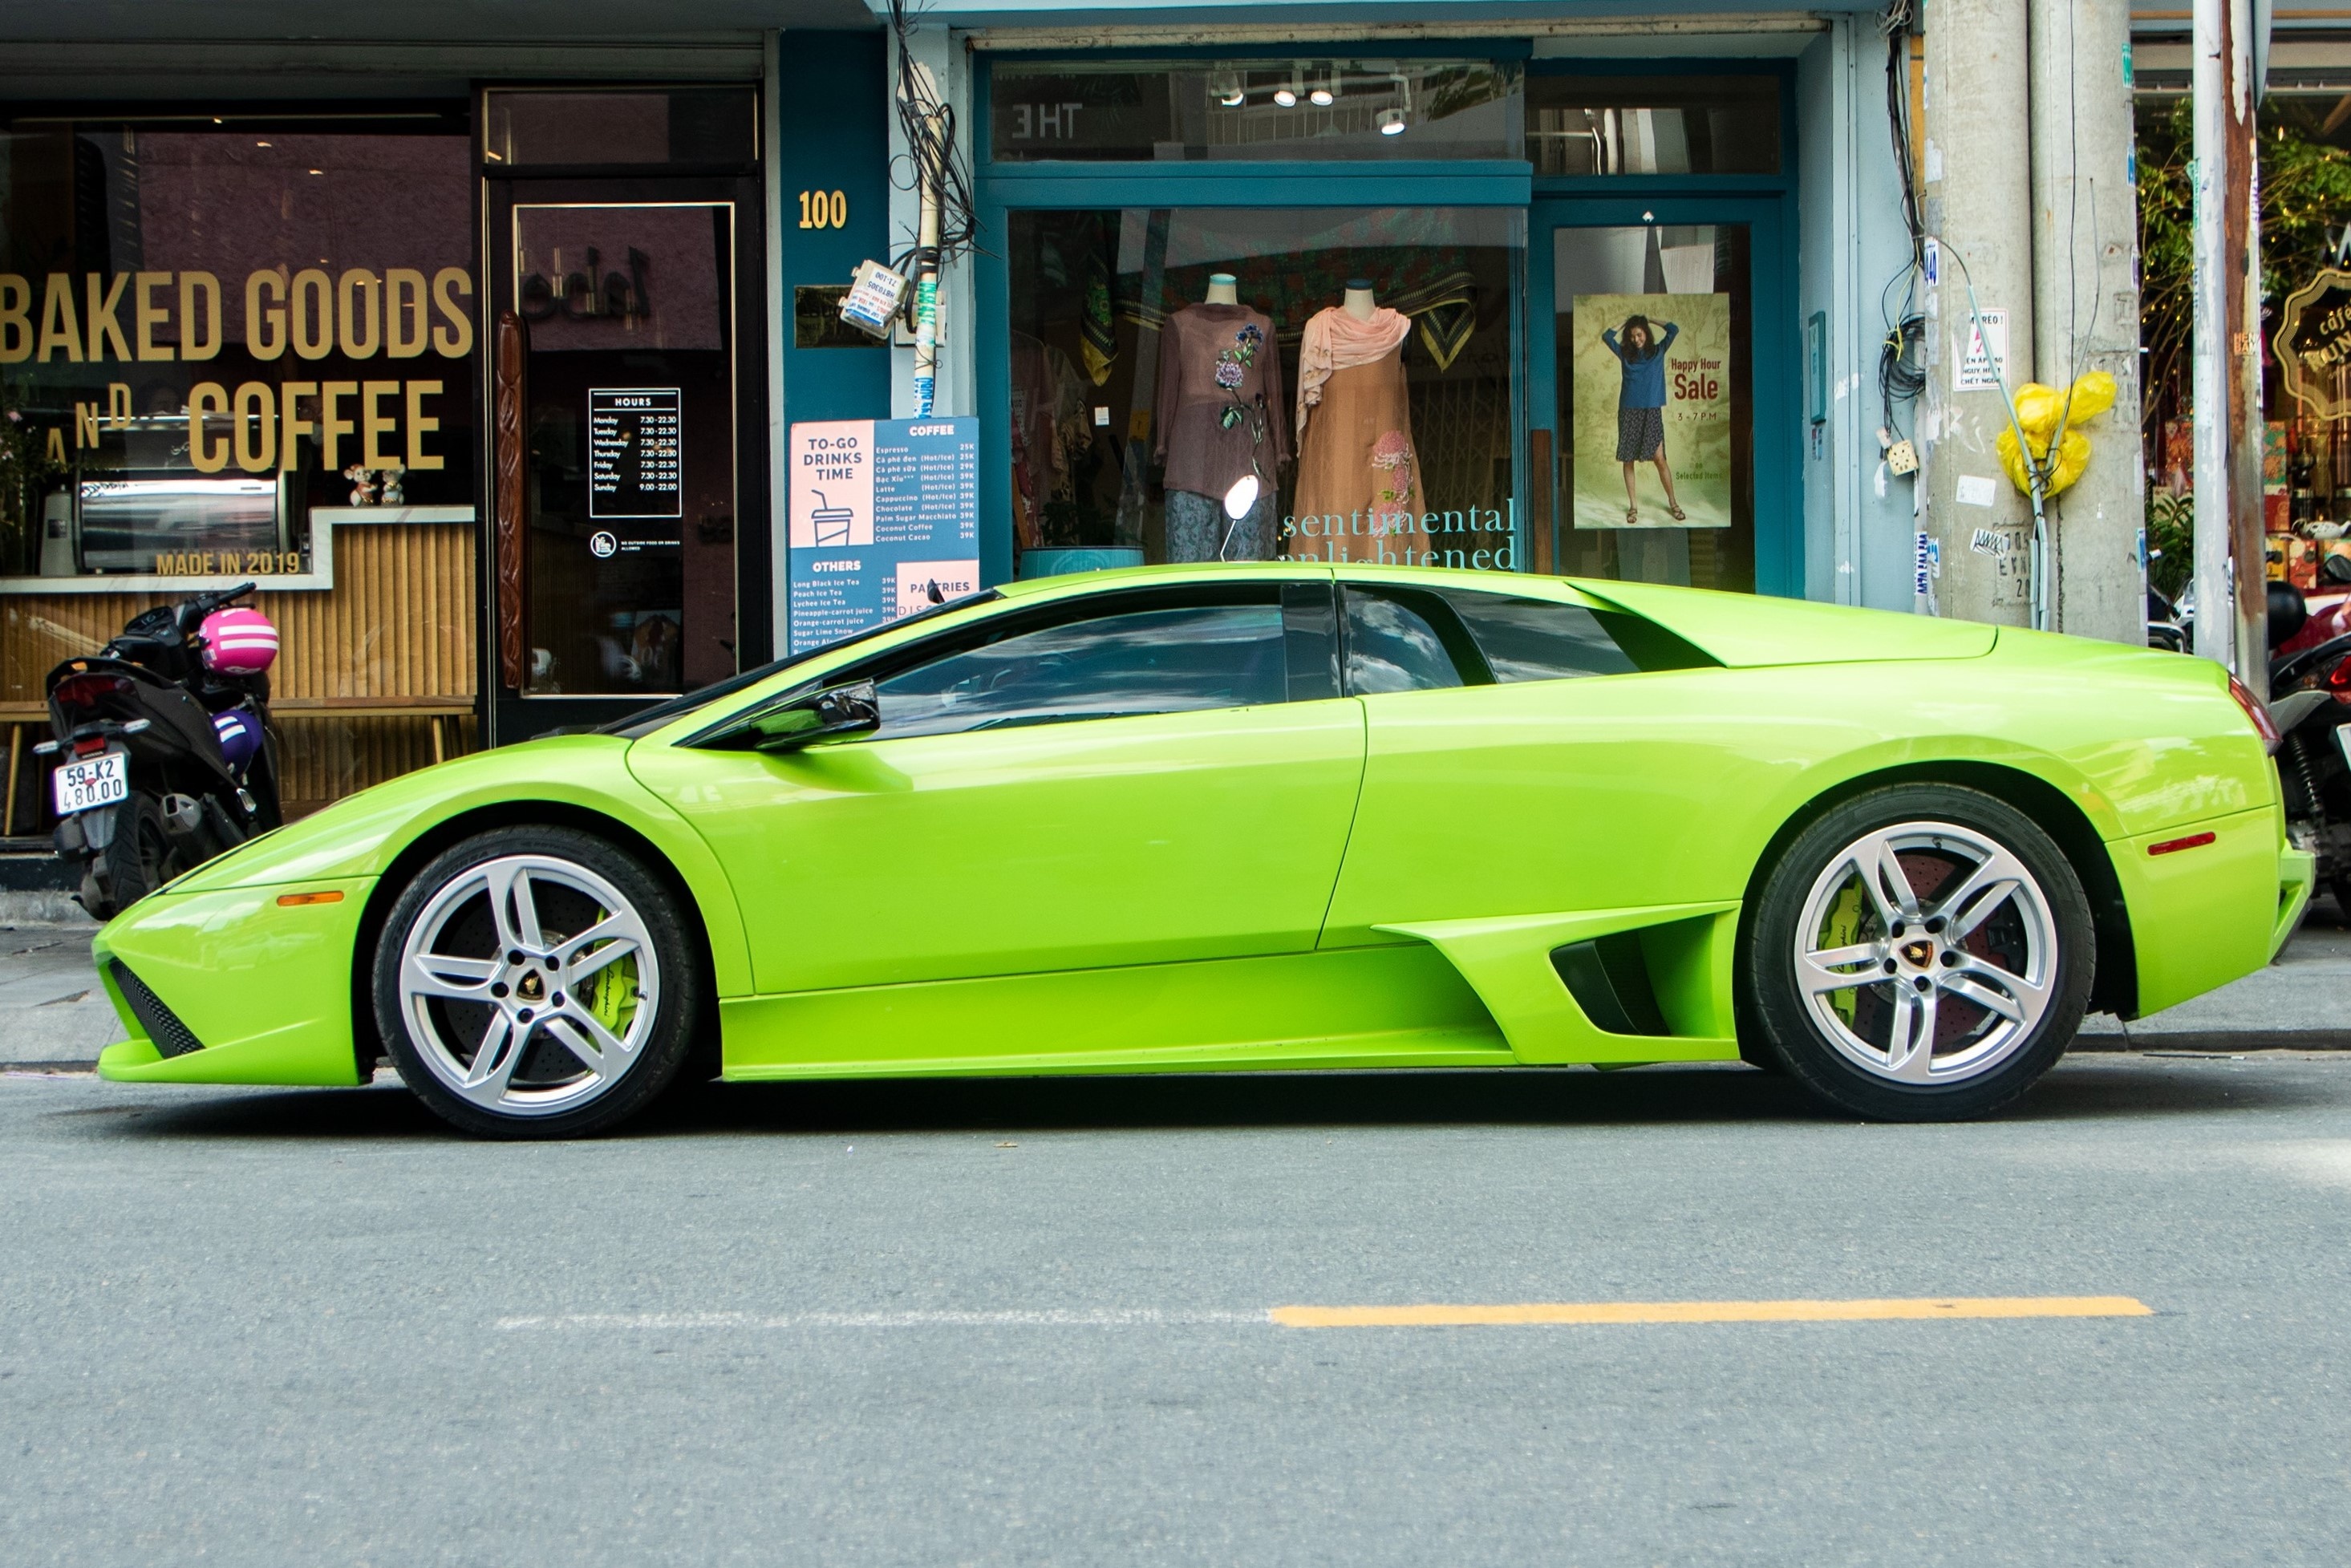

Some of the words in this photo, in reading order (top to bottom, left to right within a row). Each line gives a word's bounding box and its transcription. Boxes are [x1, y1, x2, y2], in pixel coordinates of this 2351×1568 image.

[799, 189, 847, 229] 100
[0, 271, 222, 363] BAKED
[245, 267, 473, 361] GOODS
[1672, 358, 1698, 373] Happy
[1700, 358, 1721, 371] Hour
[1674, 373, 1718, 400] Sale
[614, 398, 651, 407] HOURS
[594, 416, 618, 425] Monday
[1678, 413, 1683, 421] 3
[1693, 412, 1698, 420] 7
[46, 383, 132, 473] AND
[188, 380, 445, 473] COFFEE
[909, 425, 955, 436] COFFEE
[594, 427, 618, 436] Tuesday
[594, 439, 629, 448] Wednesday
[808, 437, 857, 451] TO-GO
[594, 451, 621, 459] Thursday
[804, 452, 862, 466] DRINKS
[921, 454, 955, 462] (Hot/Ice)
[594, 462, 613, 470] Friday
[921, 464, 955, 472] (Hot/Ice)
[594, 472, 621, 481] Saturday
[816, 468, 853, 480] TIME
[921, 473, 955, 482] (Hot/Ice)
[594, 484, 618, 492] Sunday
[921, 483, 955, 492] (Hot/Ice)
[876, 495, 918, 503] Cappuccino
[922, 493, 956, 501] (Hot/Ice)
[921, 503, 955, 511] (Hot/Ice)
[1283, 498, 1516, 537] sentimental
[156, 553, 214, 576] MADE
[221, 553, 241, 575] IN
[246, 551, 301, 574] 2019
[813, 561, 861, 573] OTHERS
[910, 582, 970, 594] PARIES
[793, 600, 818, 608] Lychee
[793, 608, 853, 617] Pineapple-carrot
[793, 619, 845, 627] Orange-carrot
[847, 618, 865, 626] juice
[794, 638, 819, 646] Orange
[67, 760, 114, 787] 59-K2
[64, 779, 122, 809] 480.00
